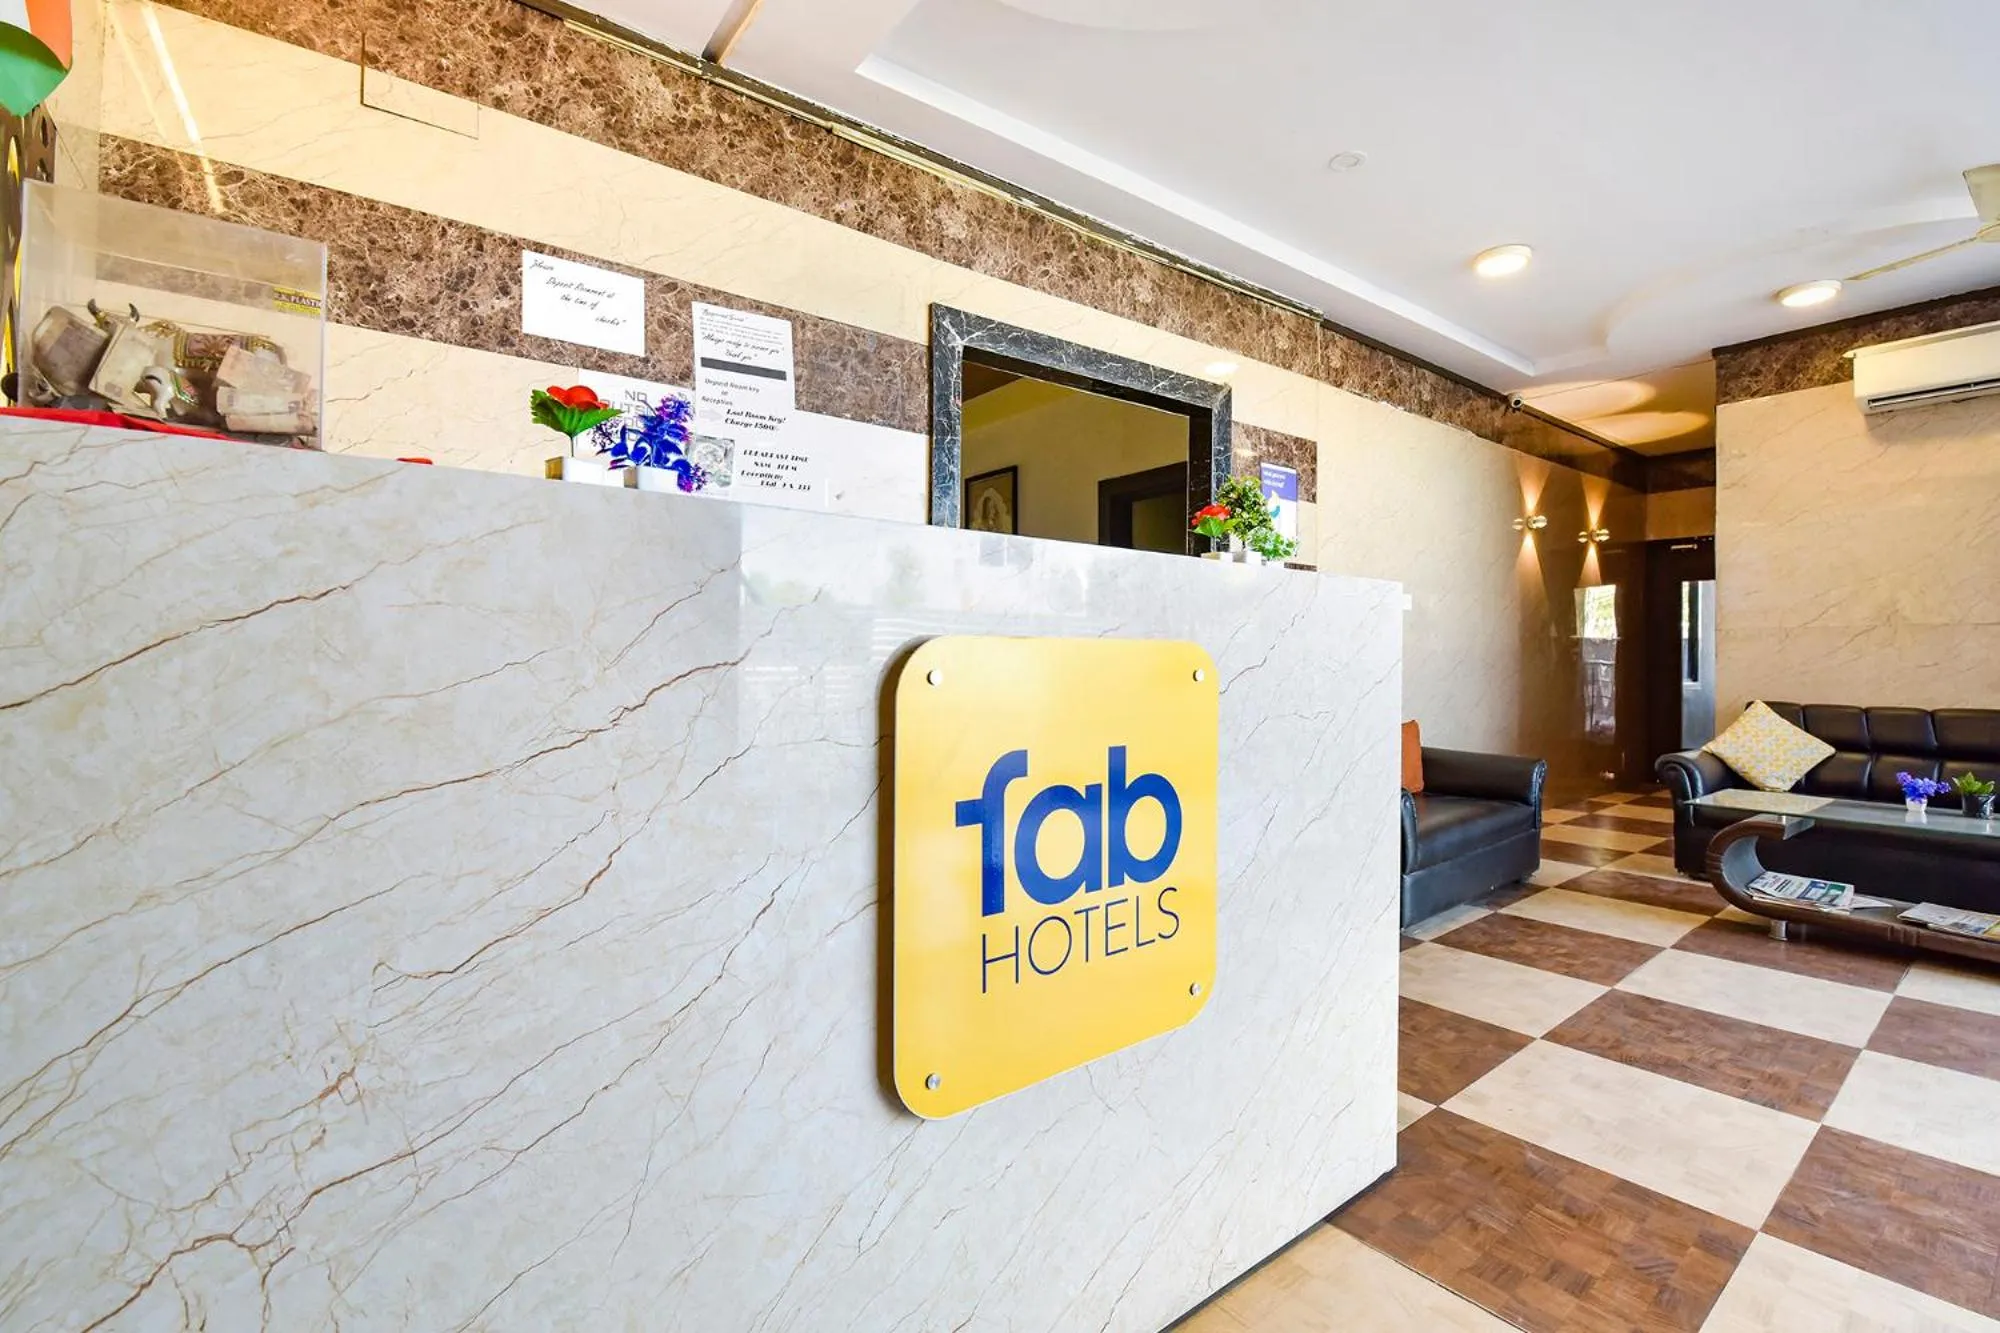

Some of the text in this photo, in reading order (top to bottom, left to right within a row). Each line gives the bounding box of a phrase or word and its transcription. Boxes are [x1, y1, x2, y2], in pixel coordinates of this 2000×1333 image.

[560, 294, 571, 302] the
[624, 389, 648, 402] NO
[744, 410, 767, 420] Room
[955, 745, 1182, 917] fab
[982, 887, 1180, 994] HOTELS
